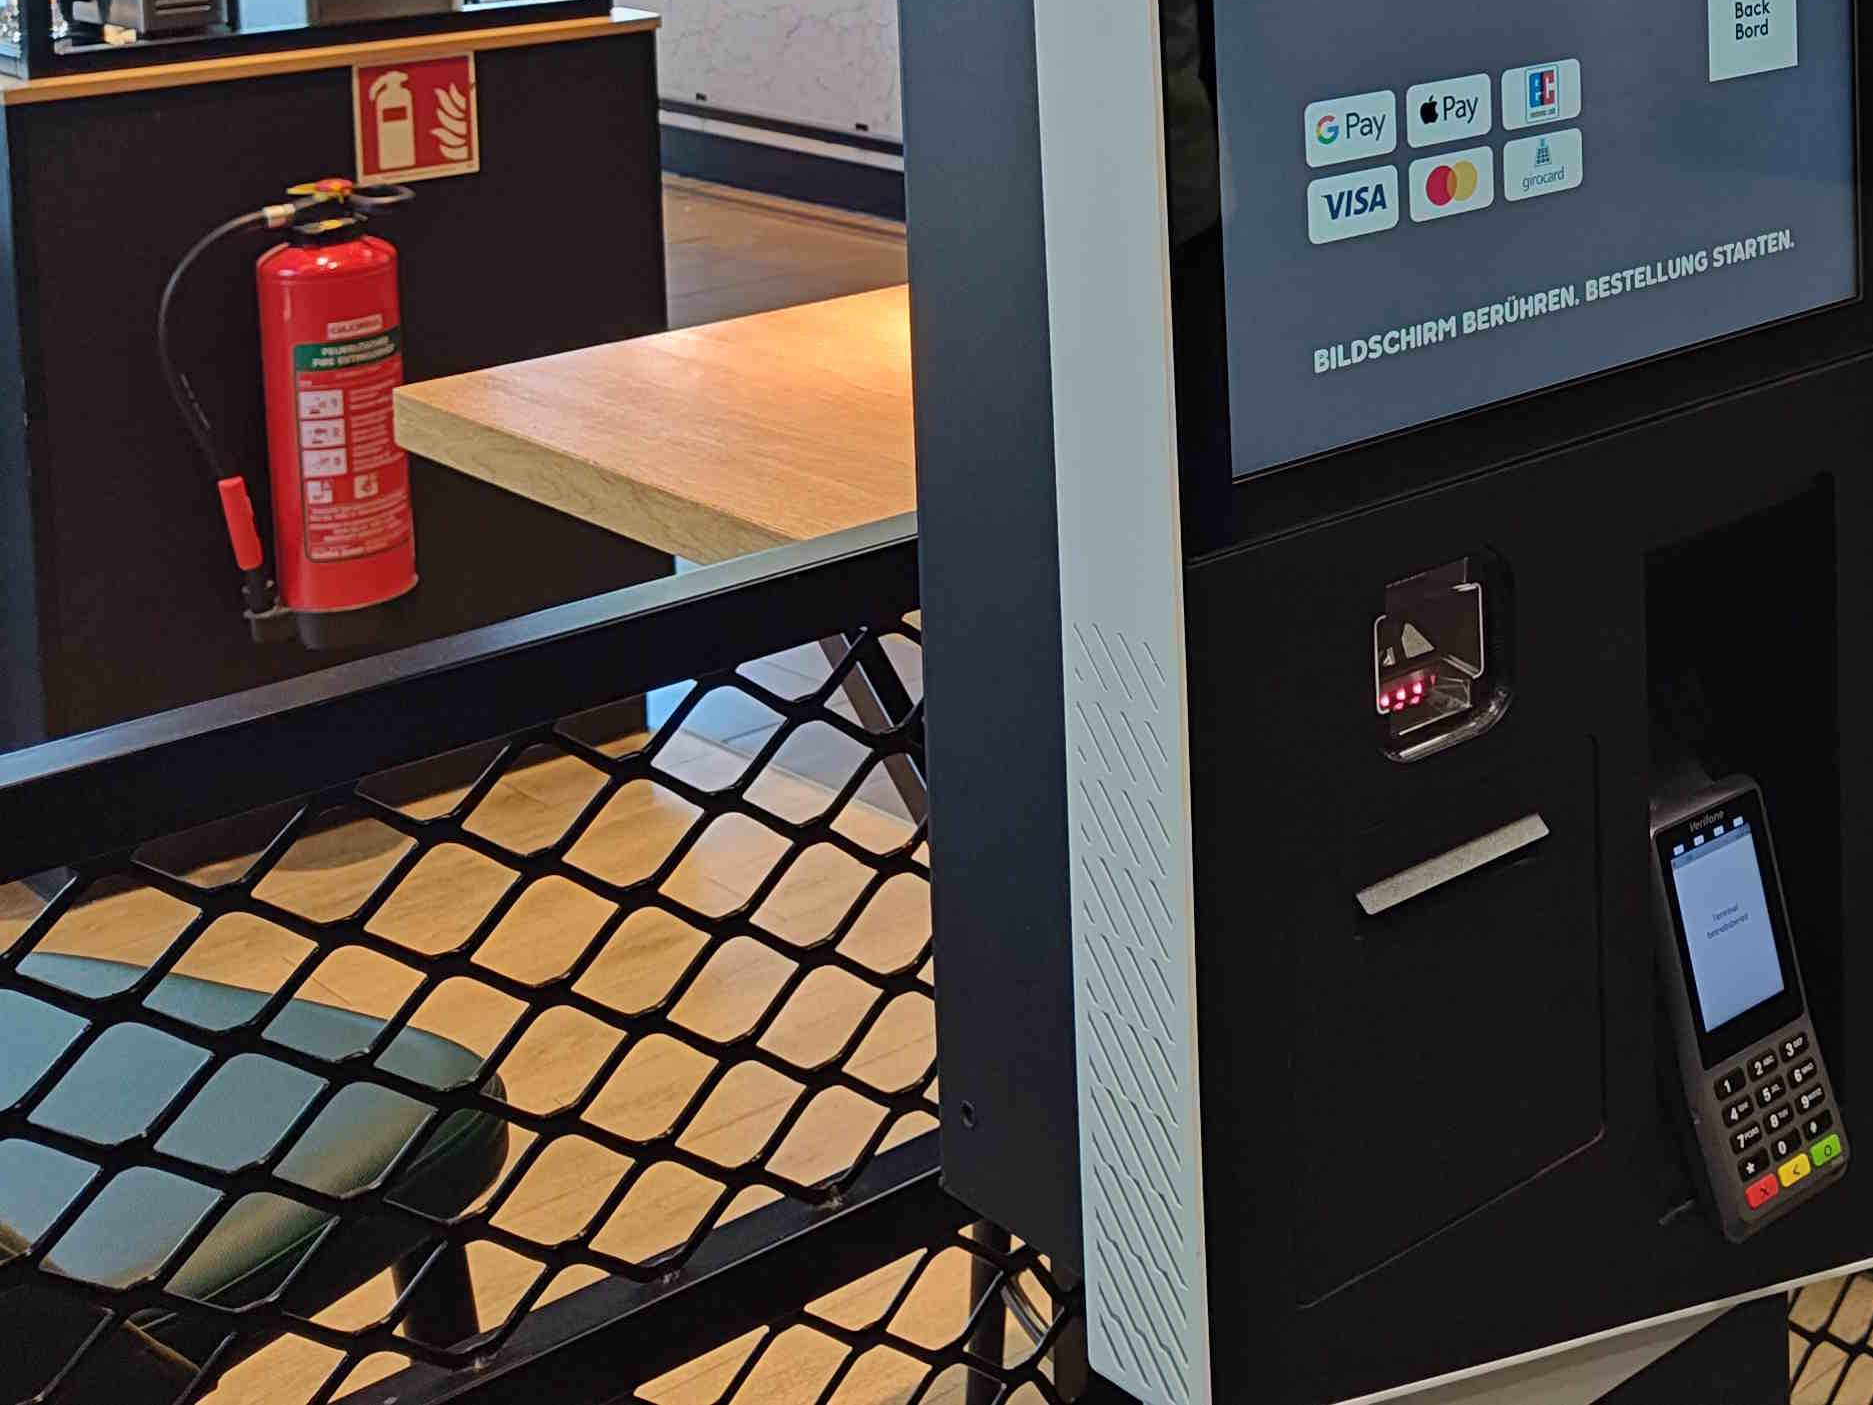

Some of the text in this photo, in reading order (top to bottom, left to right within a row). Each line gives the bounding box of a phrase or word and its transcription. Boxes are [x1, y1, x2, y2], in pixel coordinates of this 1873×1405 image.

[1735, 19, 1769, 41] Bord
[1442, 95, 1479, 124] Pay
[1345, 111, 1386, 140] Pay
[1522, 165, 1565, 192] girocard
[1321, 183, 1388, 221] VISA
[1313, 228, 1795, 374] BILDSCHIRM BERÜHREN. BESTELLUNG STARTEN.
[1785, 1042, 1795, 1057] 3
[1754, 1061, 1764, 1076] 2
[1793, 1068, 1802, 1083] 6
[1723, 1078, 1731, 1093] 1
[1762, 1087, 1771, 1102] 5
[1800, 1095, 1810, 1110] 9
[1730, 1106, 1739, 1121] 4
[1737, 1133, 1745, 1149] 7
[1777, 1140, 1787, 1155] 0
